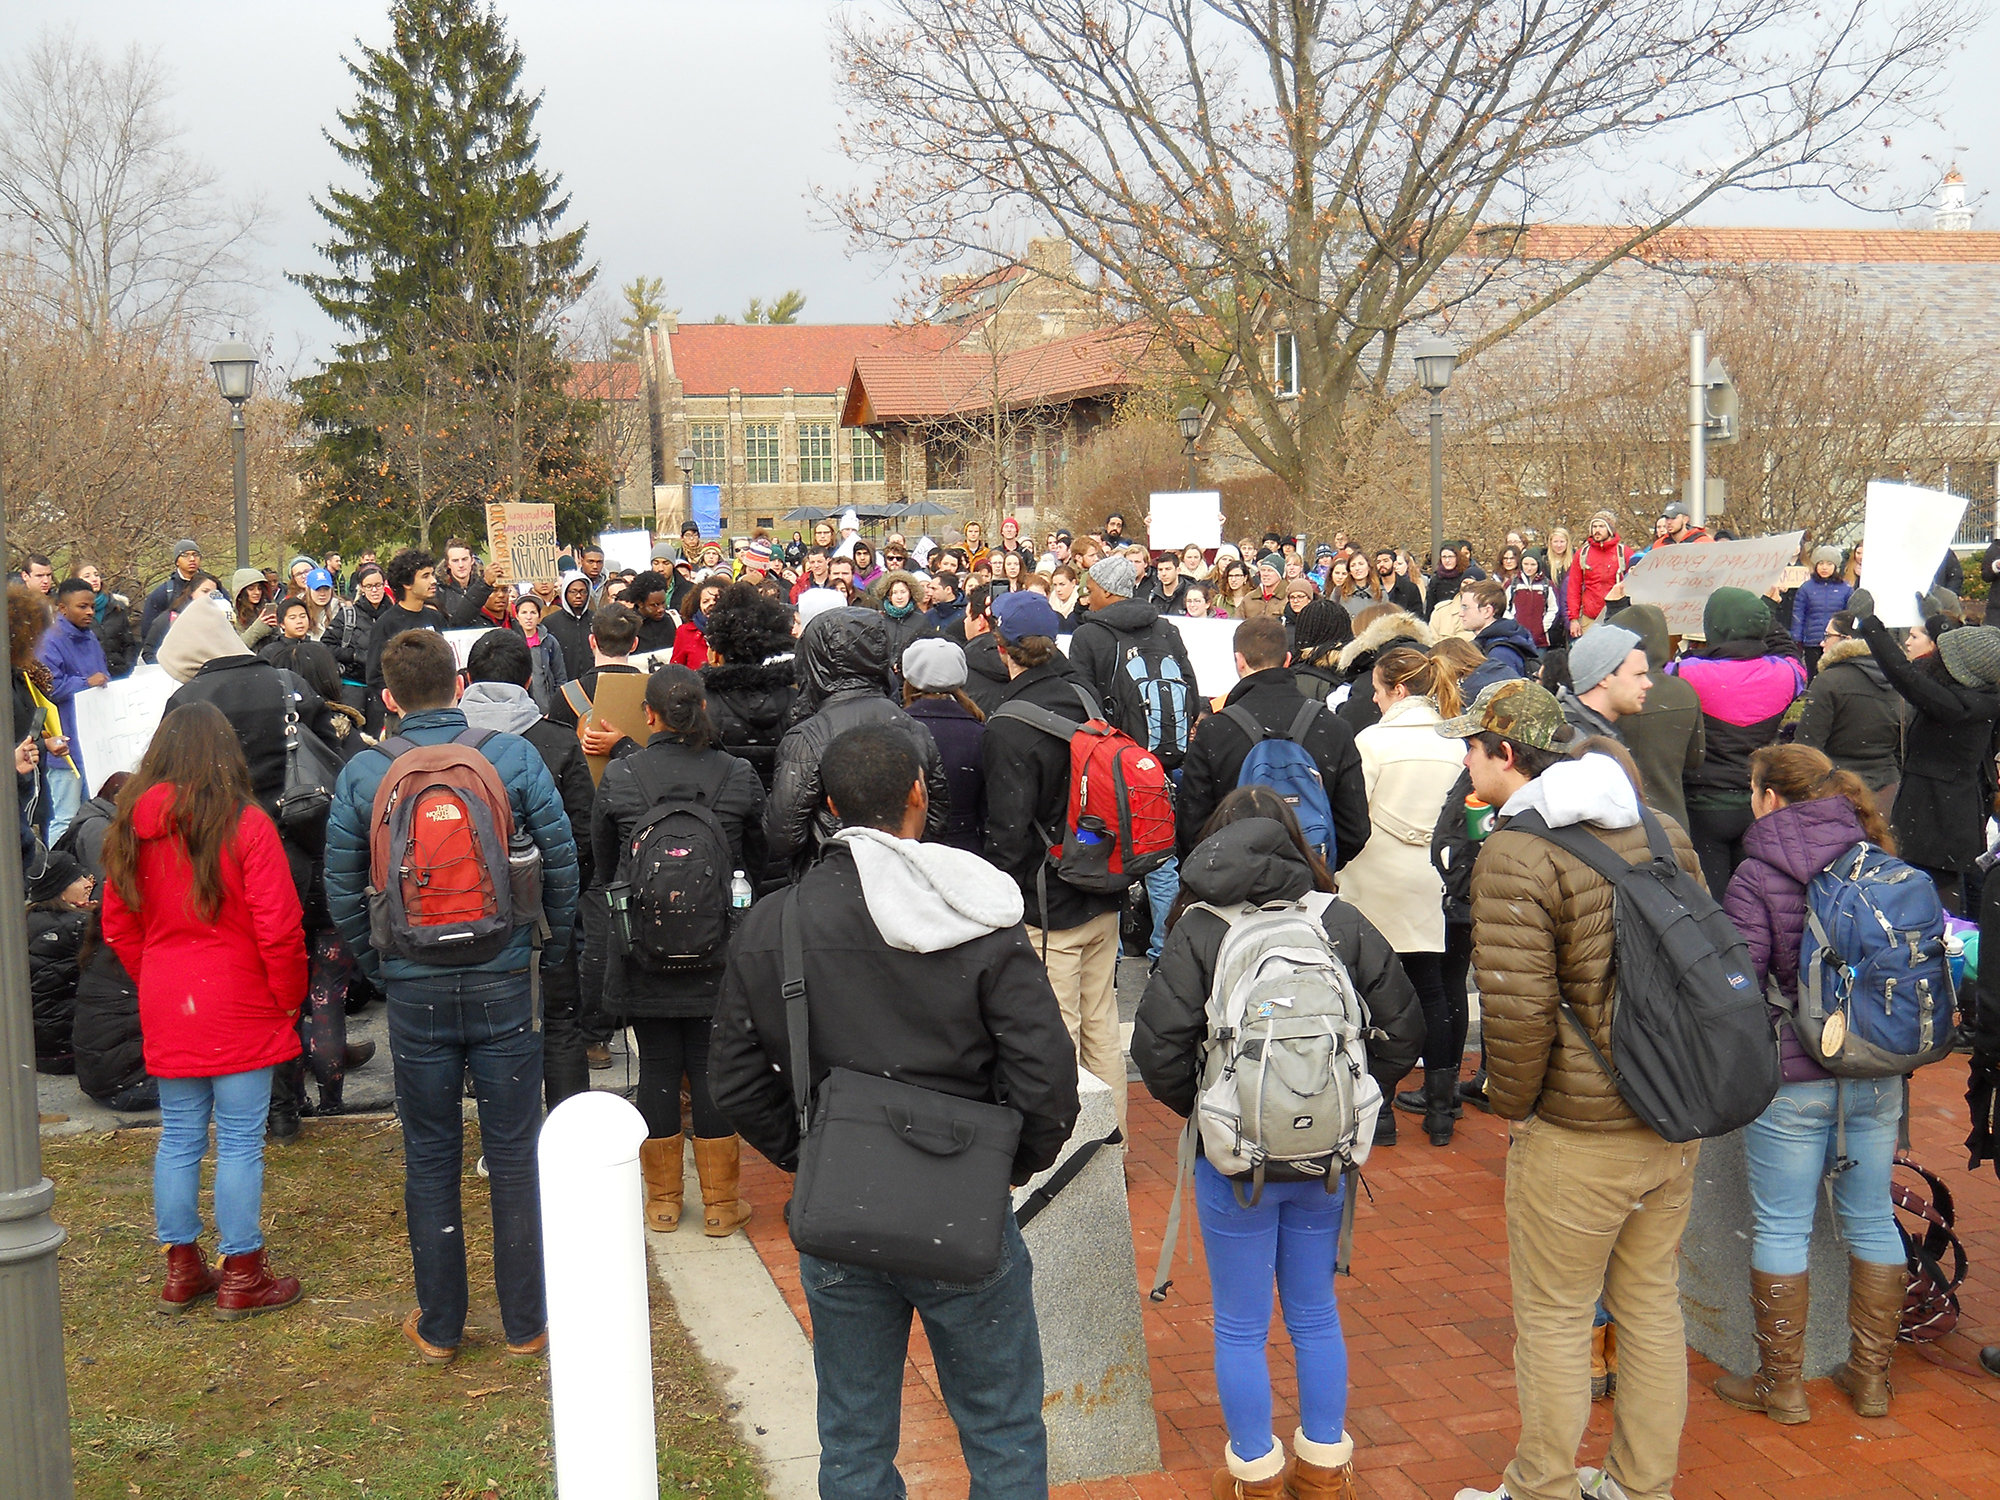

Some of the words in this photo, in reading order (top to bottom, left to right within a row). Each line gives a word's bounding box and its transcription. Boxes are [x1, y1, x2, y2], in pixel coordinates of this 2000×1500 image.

[509, 508, 540, 521] problem
[541, 506, 554, 518] my
[503, 522, 533, 534] problem
[535, 521, 555, 533] your
[513, 531, 555, 548] RIGHTS:
[511, 546, 557, 578] HUMAN
[112, 686, 150, 722] LIFE
